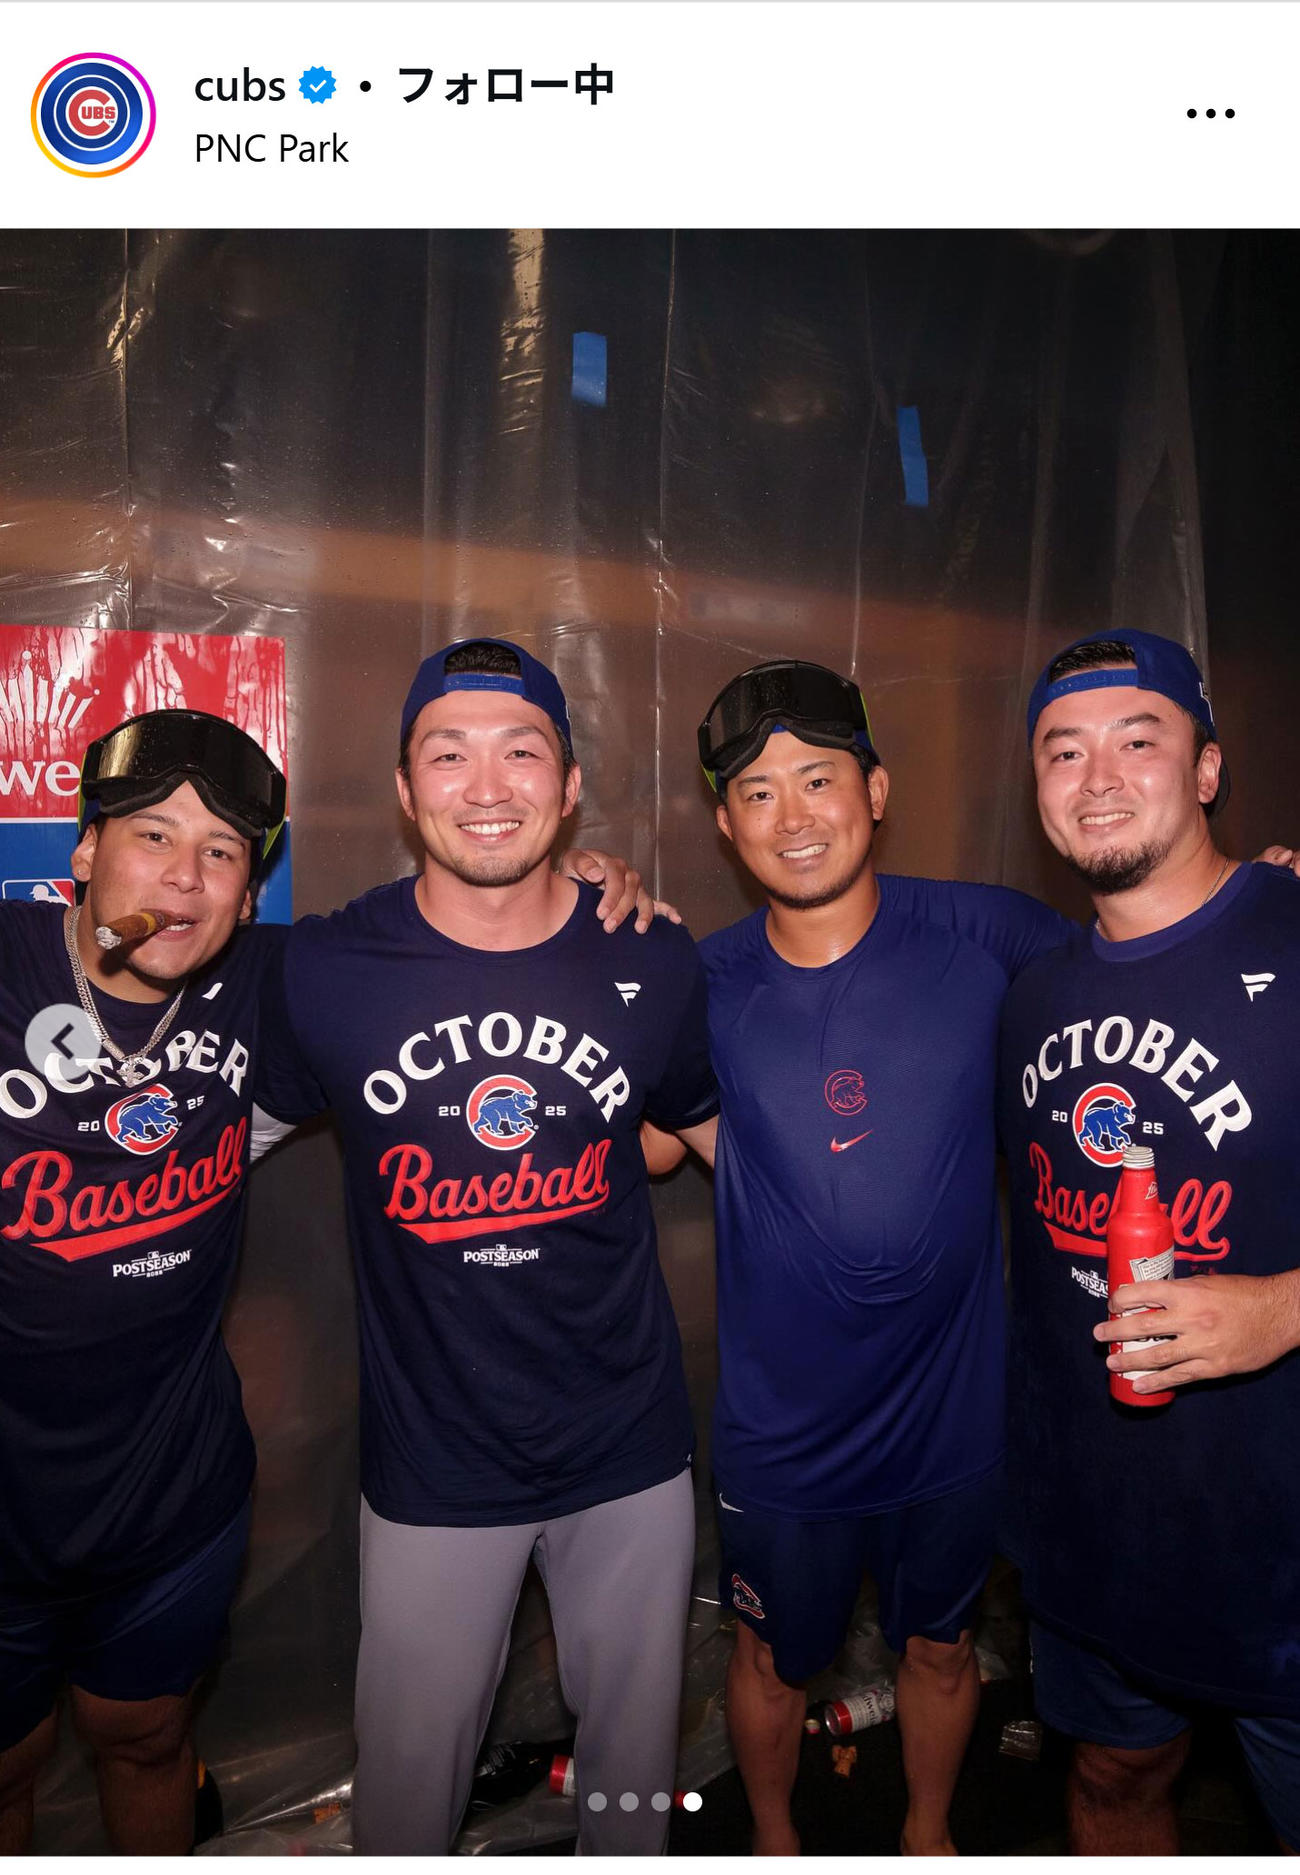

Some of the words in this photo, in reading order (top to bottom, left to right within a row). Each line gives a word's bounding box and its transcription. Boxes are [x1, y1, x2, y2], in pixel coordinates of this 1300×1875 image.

[364, 1012, 630, 1122] OCTOBER
[1023, 1016, 1252, 1151] OCTOBER
[77, 1121, 100, 1132] 20
[187, 1096, 205, 1110] 25
[439, 1106, 461, 1117] 20
[545, 1105, 567, 1116] 25
[1051, 1110, 1068, 1123] 20
[1142, 1121, 1164, 1136] 25
[0, 1117, 247, 1240] Baseball
[379, 1139, 612, 1220] Baseball
[1028, 1142, 1233, 1250] Basell
[113, 1249, 191, 1278] POSTSEASON
[463, 1248, 540, 1263] POSTSEASON
